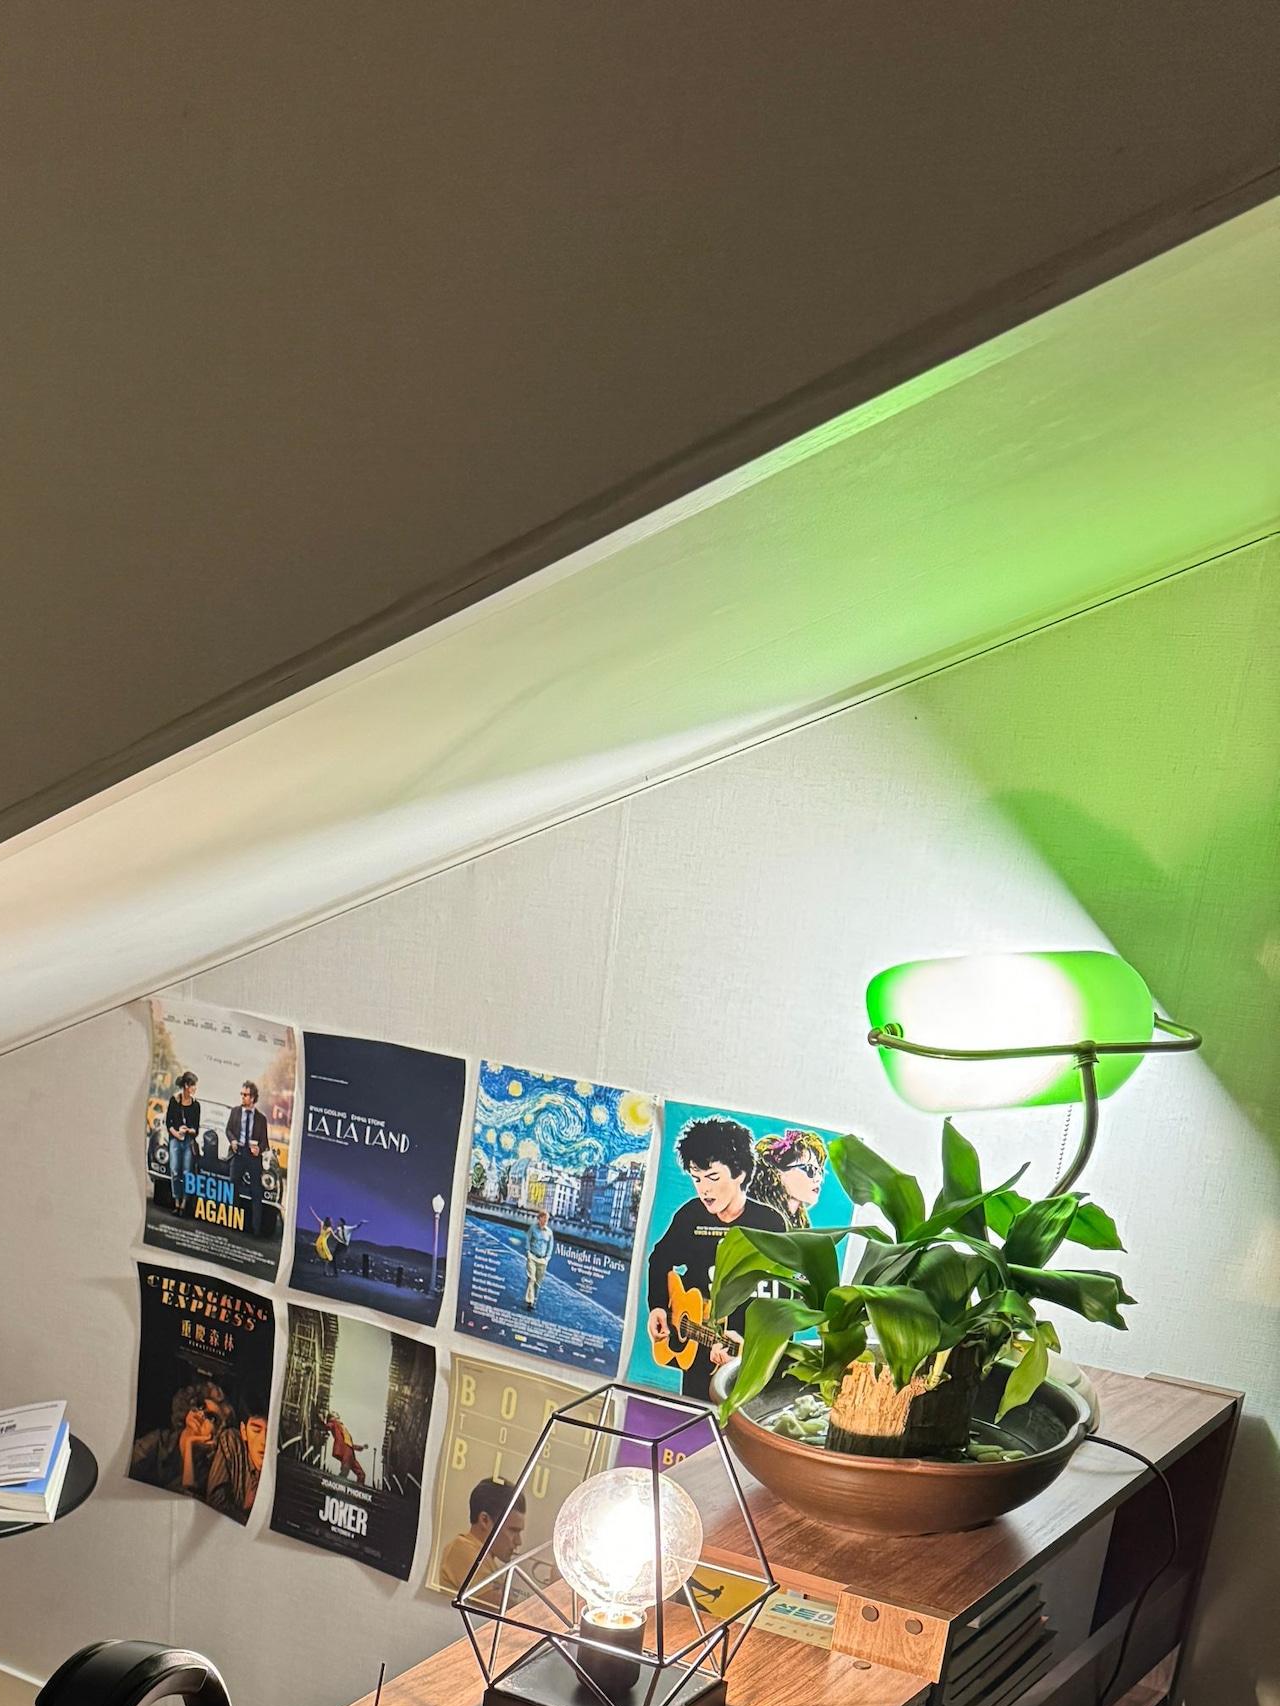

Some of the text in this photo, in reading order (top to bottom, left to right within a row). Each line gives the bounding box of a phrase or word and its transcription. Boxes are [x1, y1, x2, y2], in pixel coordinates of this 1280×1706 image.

[307, 1112, 330, 1136] LA
[336, 1119, 359, 1143] LA
[365, 1126, 410, 1154] LAND
[184, 1171, 234, 1205] BEGIN
[194, 1197, 244, 1231] AGAIN
[555, 1243, 625, 1272] Midnight in Paris
[146, 1275, 268, 1321] CHUNGKING
[161, 1290, 256, 1332] EXPRESS
[321, 1478, 373, 1503] JOAQUIN PHOENIX
[318, 1495, 369, 1537] JOKER
